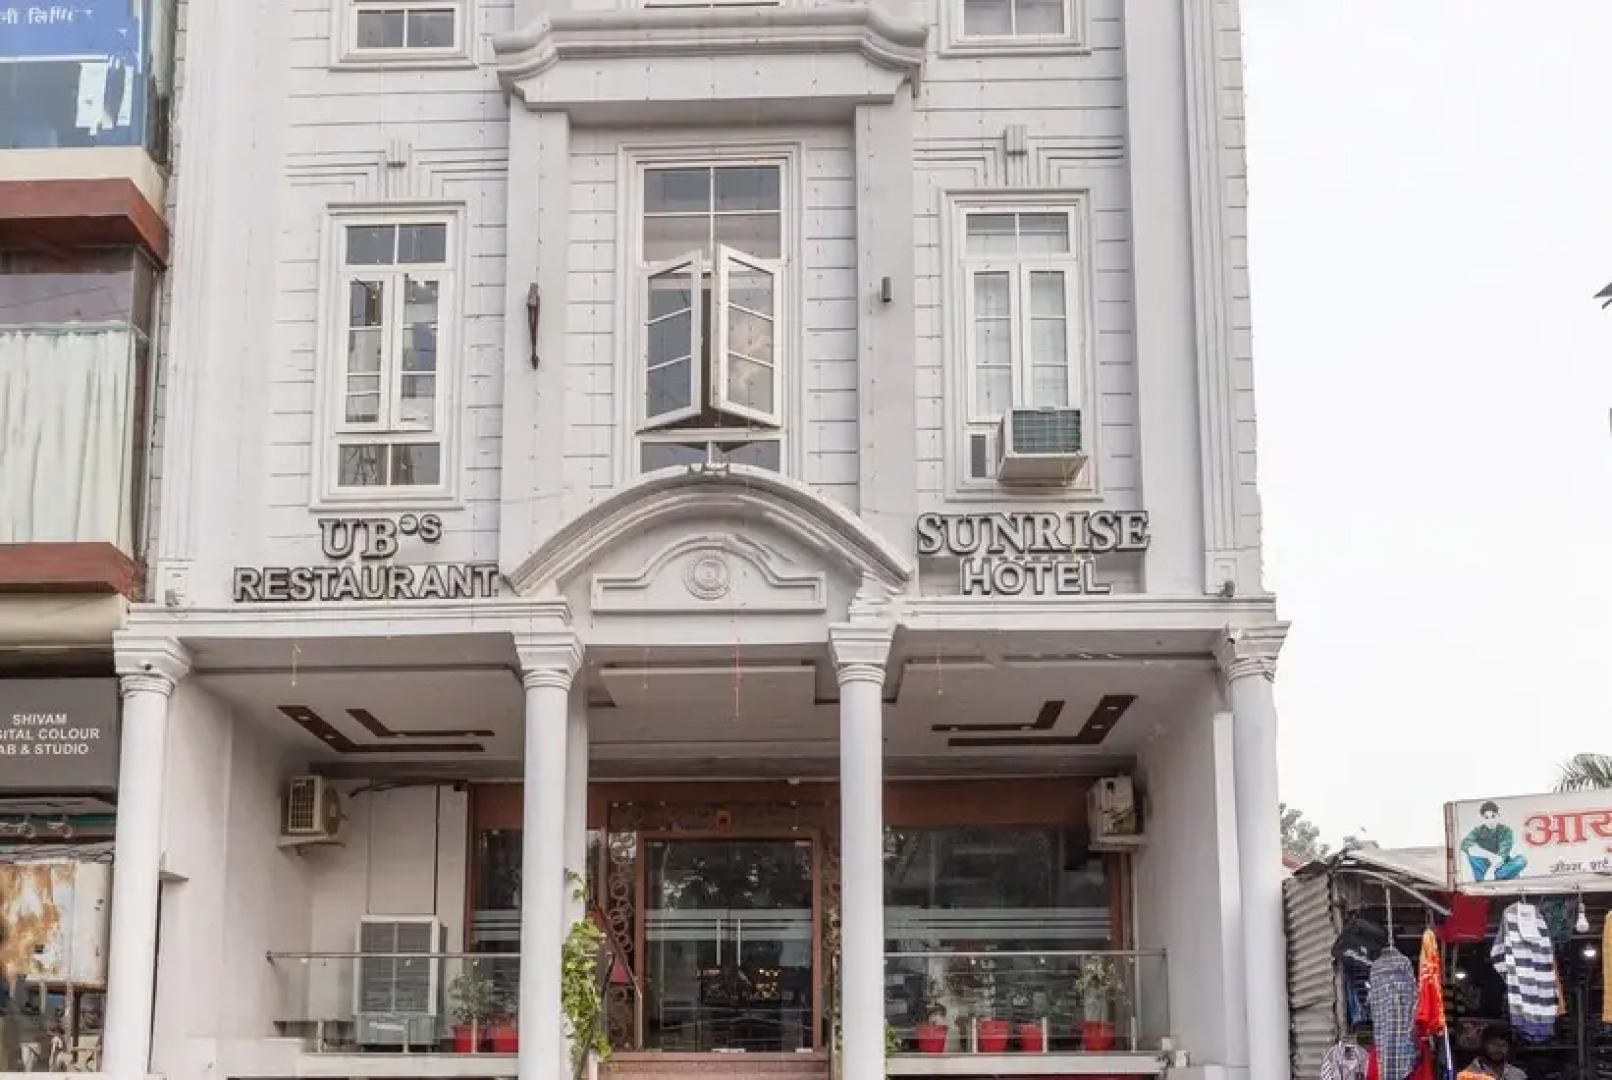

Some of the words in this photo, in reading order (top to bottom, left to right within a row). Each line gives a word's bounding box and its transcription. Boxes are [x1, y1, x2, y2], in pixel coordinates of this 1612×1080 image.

[917, 510, 1151, 553] SUNRISE
[233, 564, 500, 602] RESTAURANT
[961, 556, 1111, 596] HOTEL
[13, 713, 68, 726] SHIVAM
[38, 727, 101, 741] COLOUR
[20, 743, 31, 755] &
[34, 743, 89, 755] STUDIO
